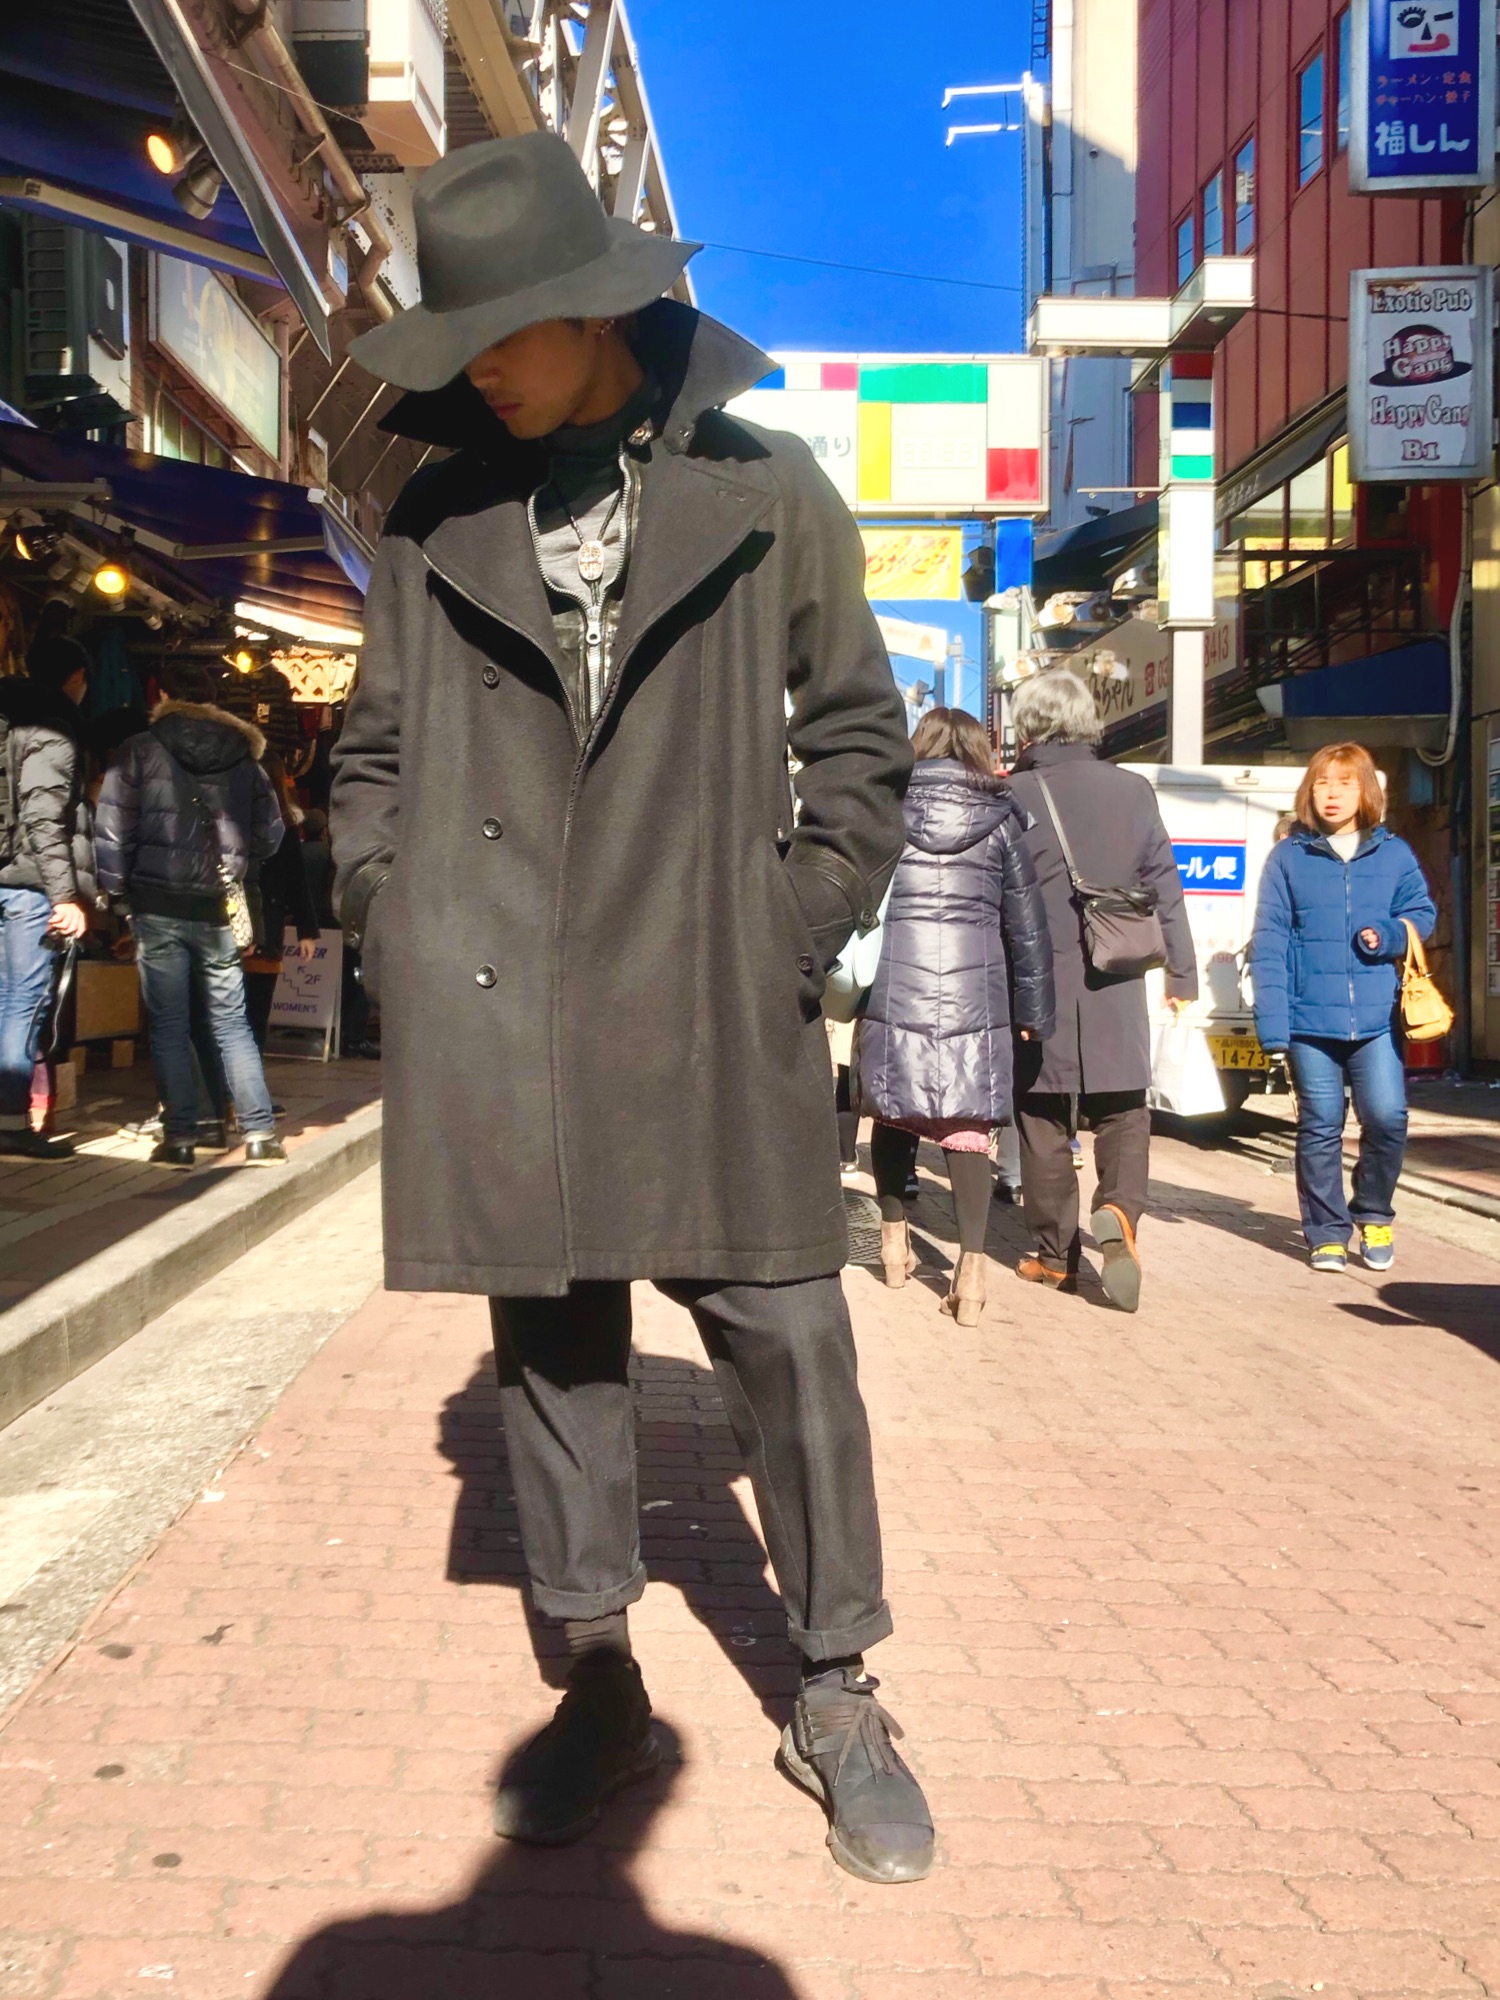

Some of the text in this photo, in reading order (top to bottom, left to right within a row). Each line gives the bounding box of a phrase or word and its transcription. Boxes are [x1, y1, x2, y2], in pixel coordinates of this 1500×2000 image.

[1375, 120, 1470, 155] 福しん
[1371, 288, 1472, 313] Exotic Pub
[304, 974, 322, 985] 2F
[272, 1001, 318, 1014] WOMEN'S
[1221, 1050, 1266, 1067] 14-73
